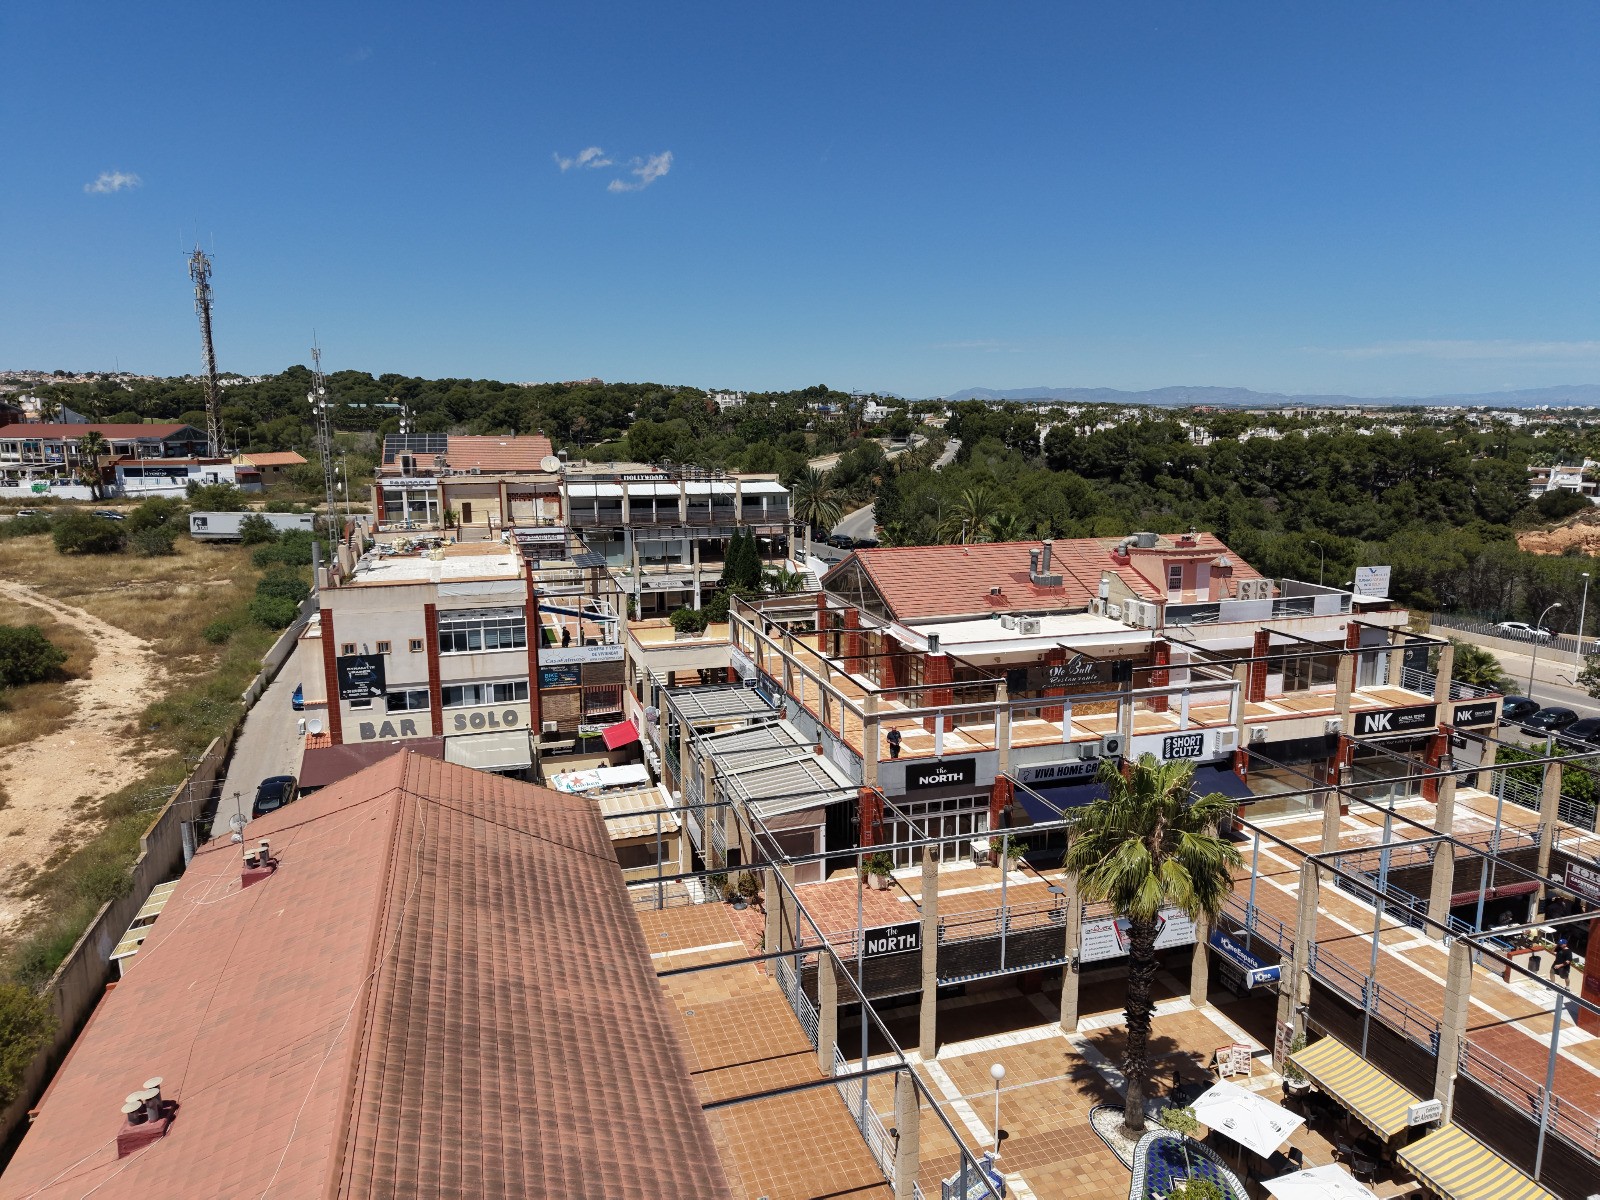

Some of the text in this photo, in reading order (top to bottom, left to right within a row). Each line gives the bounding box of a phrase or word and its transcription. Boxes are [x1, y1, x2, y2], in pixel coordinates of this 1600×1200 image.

[454, 709, 519, 731] SOLO
[1456, 710, 1473, 721] NK
[1364, 712, 1393, 733] NK
[359, 718, 418, 740] BAR
[1172, 736, 1201, 748] SHORT
[1172, 746, 1200, 757] CUTZ
[936, 766, 947, 774] The
[1034, 766, 1055, 779] VIVA
[1056, 764, 1084, 776] HOME
[919, 773, 963, 785] NORTH
[886, 926, 898, 937] The
[868, 933, 916, 954] NORTH
